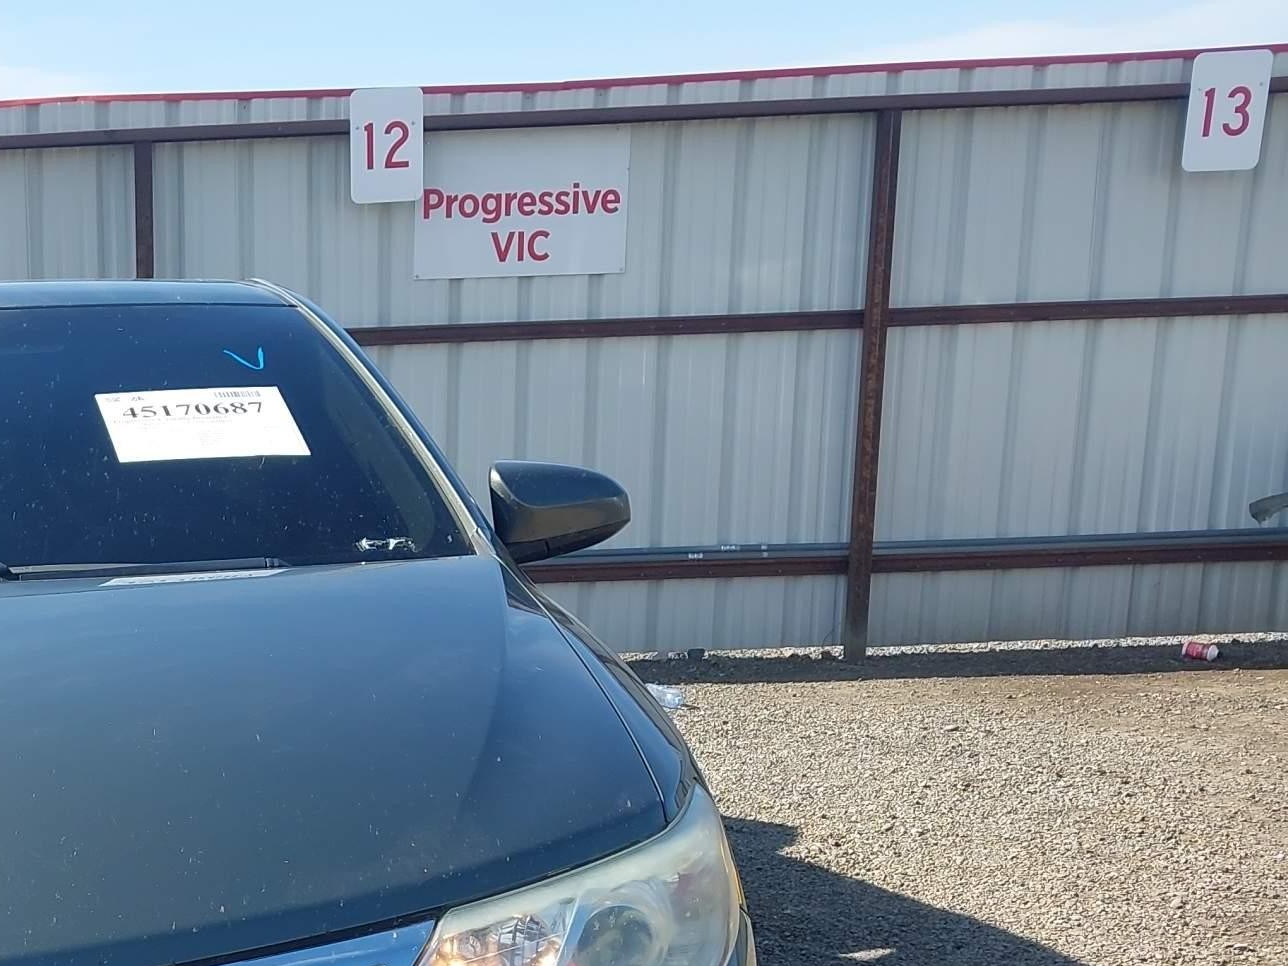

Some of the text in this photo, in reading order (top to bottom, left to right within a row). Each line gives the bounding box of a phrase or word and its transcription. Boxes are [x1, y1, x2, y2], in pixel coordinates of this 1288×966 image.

[1202, 86, 1252, 137] 13
[364, 120, 410, 170] 12
[423, 182, 621, 223] Progressive
[490, 229, 550, 263] VIC
[123, 401, 263, 419] 45170687
